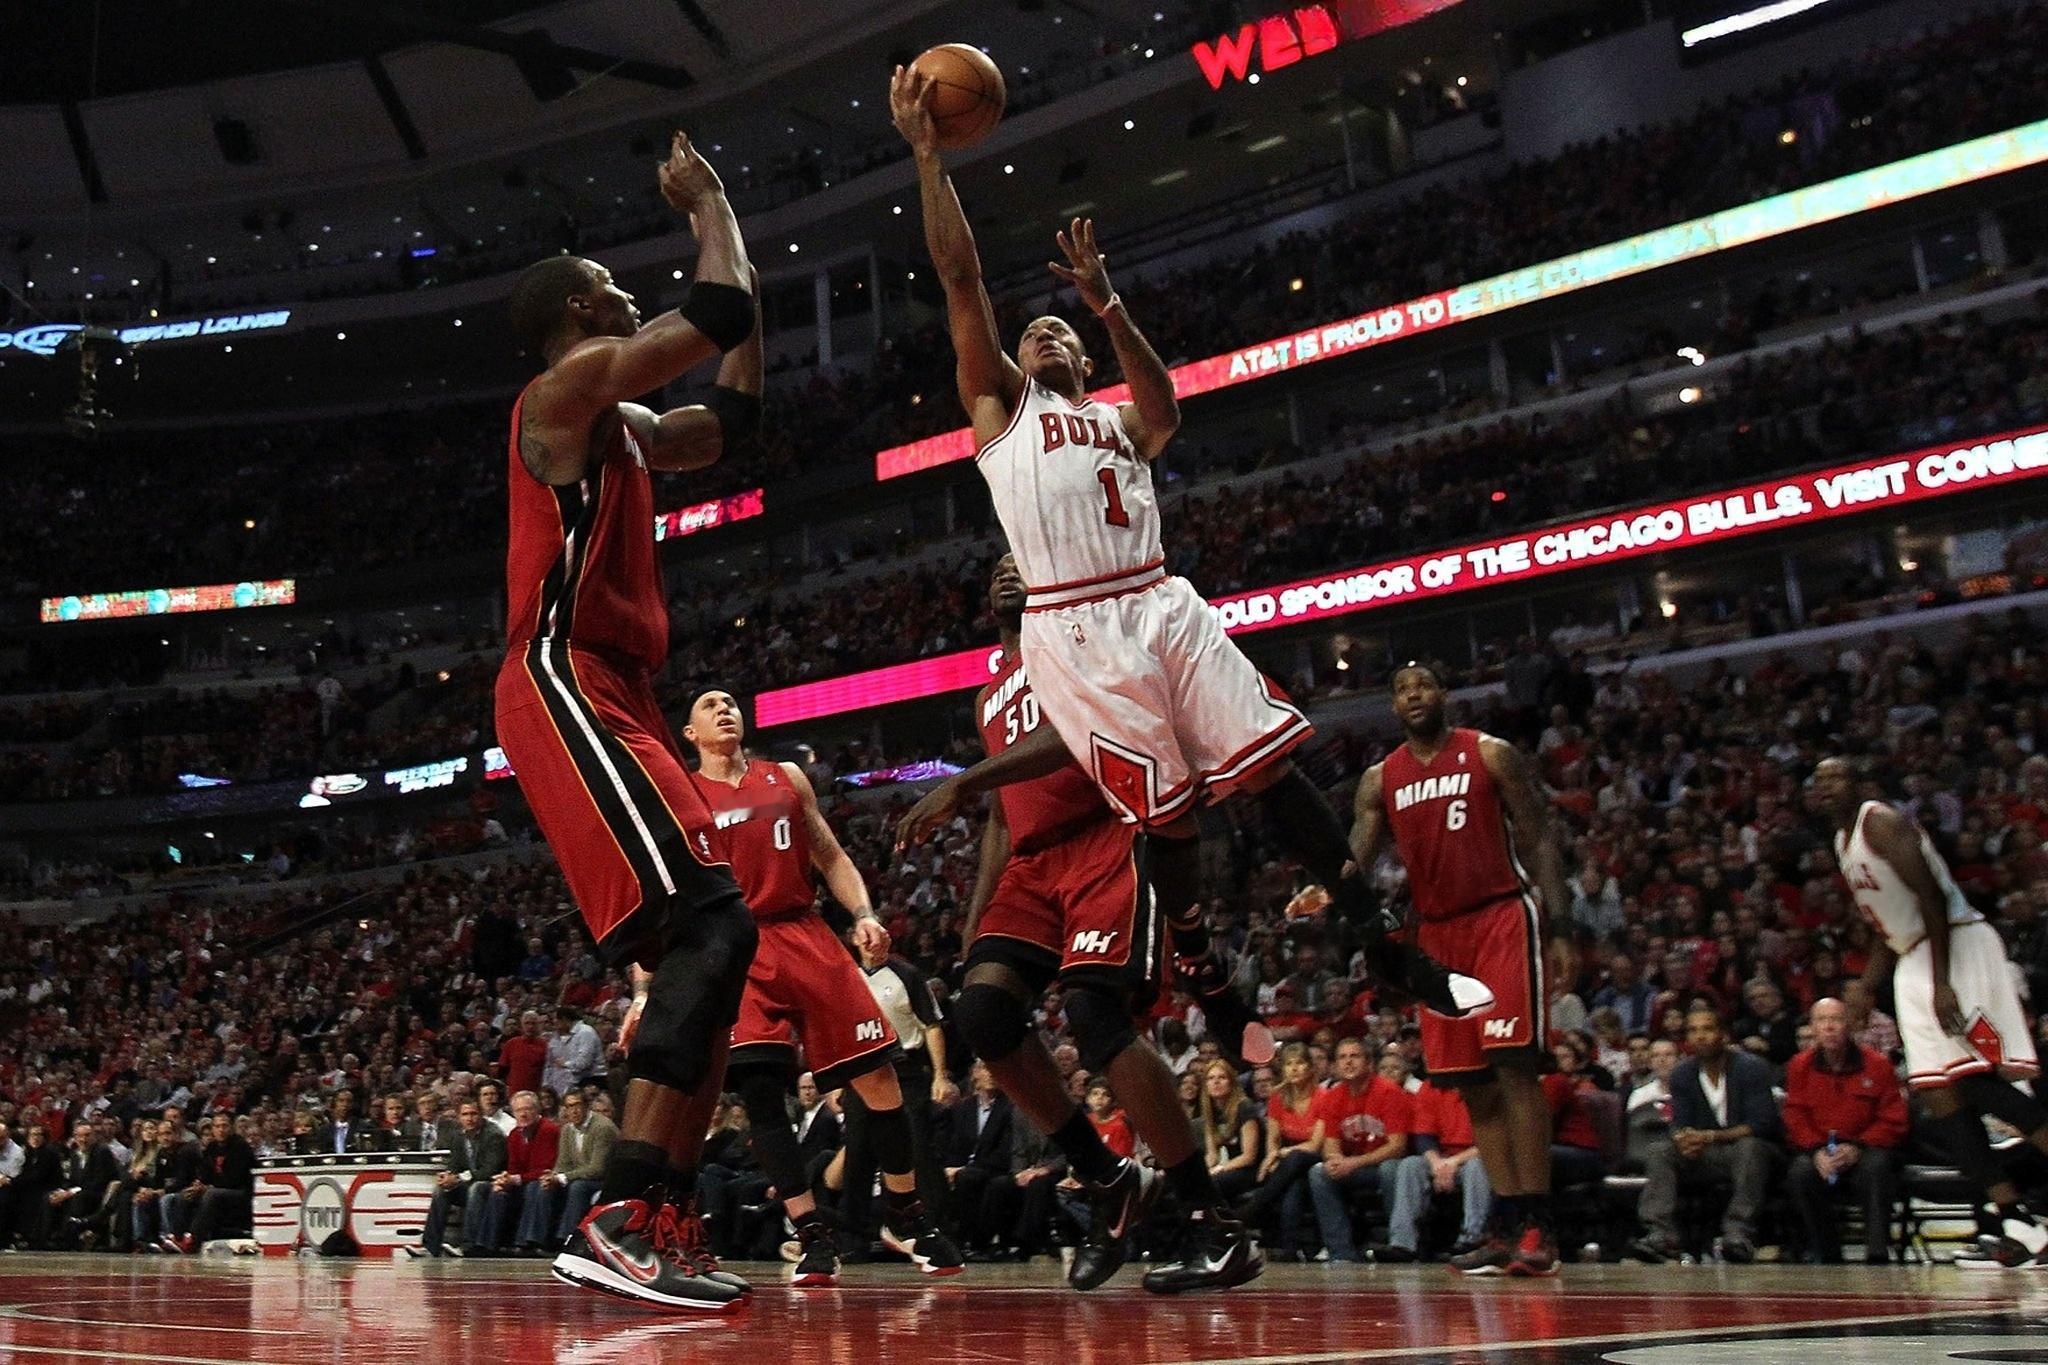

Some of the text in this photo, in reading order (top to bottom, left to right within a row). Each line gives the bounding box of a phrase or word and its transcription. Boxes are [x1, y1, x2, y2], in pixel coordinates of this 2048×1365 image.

[1229, 341, 1291, 379] AT&T
[1295, 333, 1319, 361] IS
[1322, 308, 1404, 353] PROUD
[1407, 298, 1445, 329] TO
[1097, 467, 1130, 528] 1
[1279, 565, 1417, 617] SPONSOR
[1419, 554, 1463, 589] OF
[1466, 540, 1532, 580] THE
[1533, 509, 1685, 566] CHICAGO
[1813, 461, 1911, 509] VISIT
[983, 664, 1030, 727] MIAM
[1005, 691, 1040, 745] 50
[1394, 772, 1471, 812] MIAMI
[1446, 799, 1468, 832] 6
[773, 818, 791, 851] 0
[307, 1206, 341, 1229] TNT
